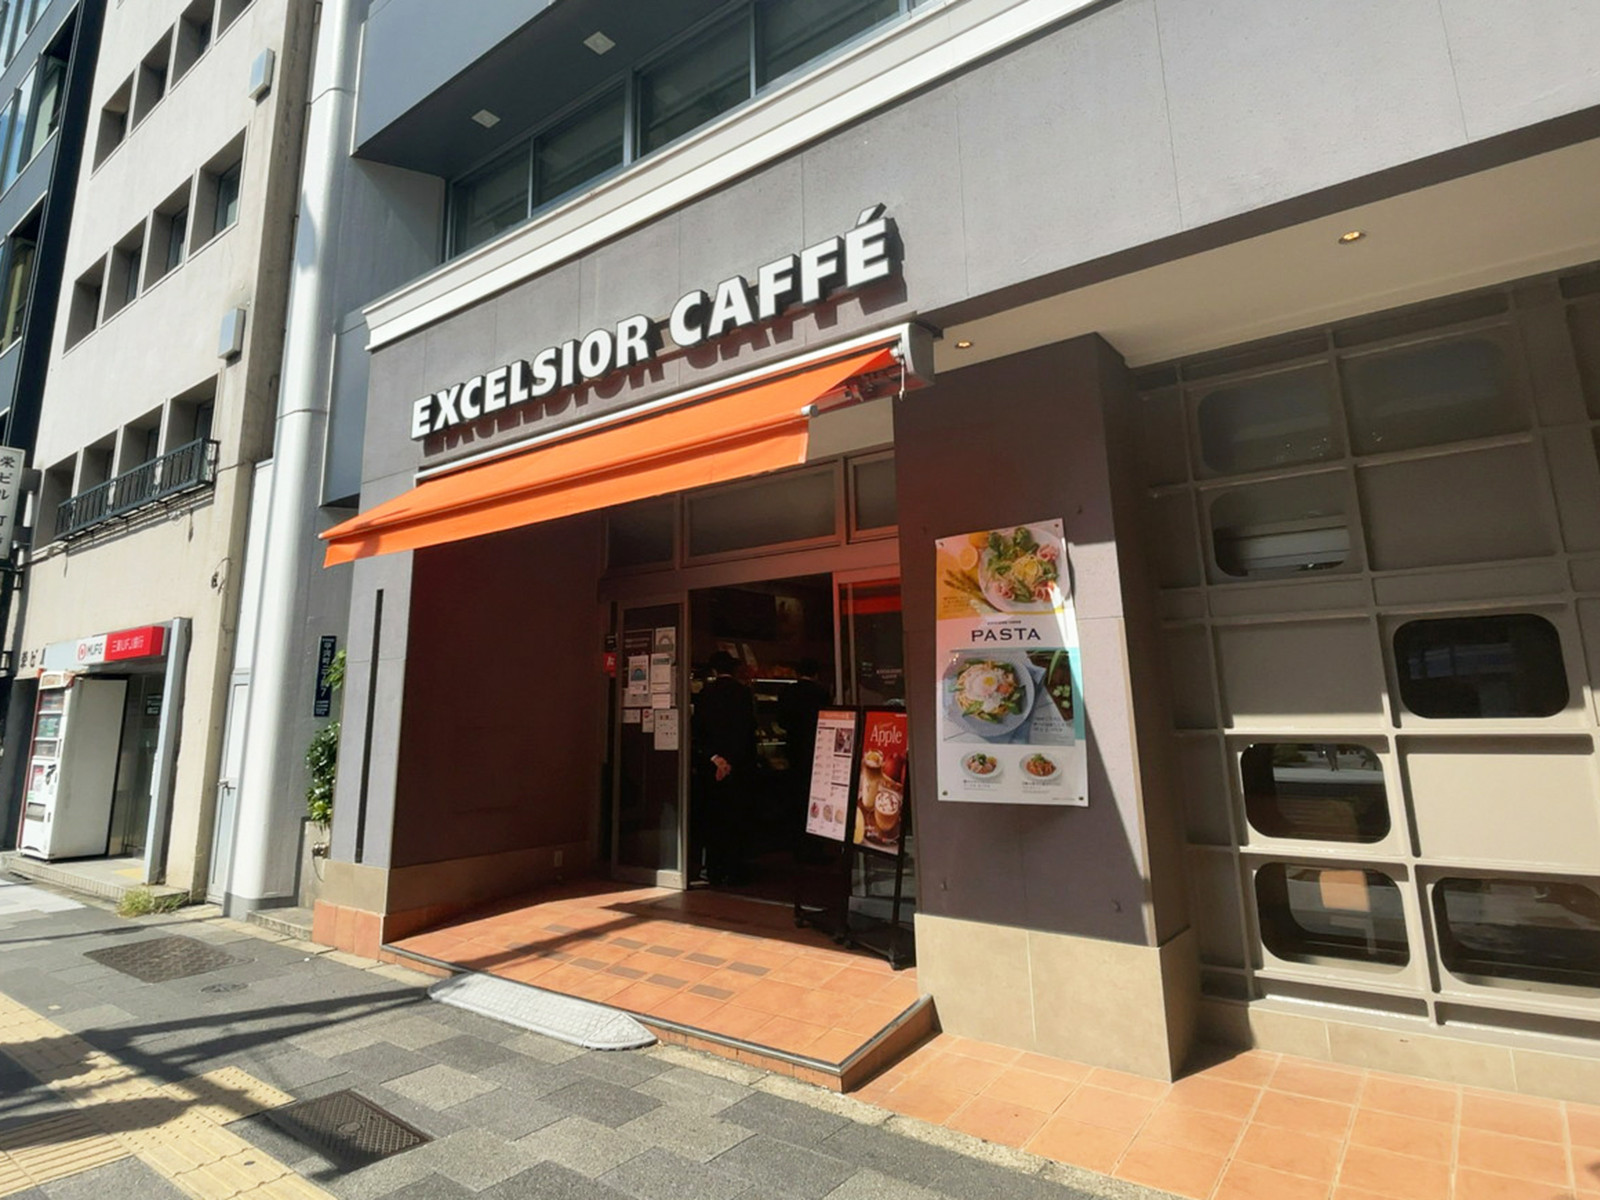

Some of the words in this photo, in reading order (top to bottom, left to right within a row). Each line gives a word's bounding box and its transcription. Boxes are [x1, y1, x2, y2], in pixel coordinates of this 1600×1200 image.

[411, 315, 649, 440] EXCELSIOR
[669, 204, 890, 347] CAFFÉ
[971, 627, 1041, 642] PASTA
[870, 725, 902, 747] Apple
